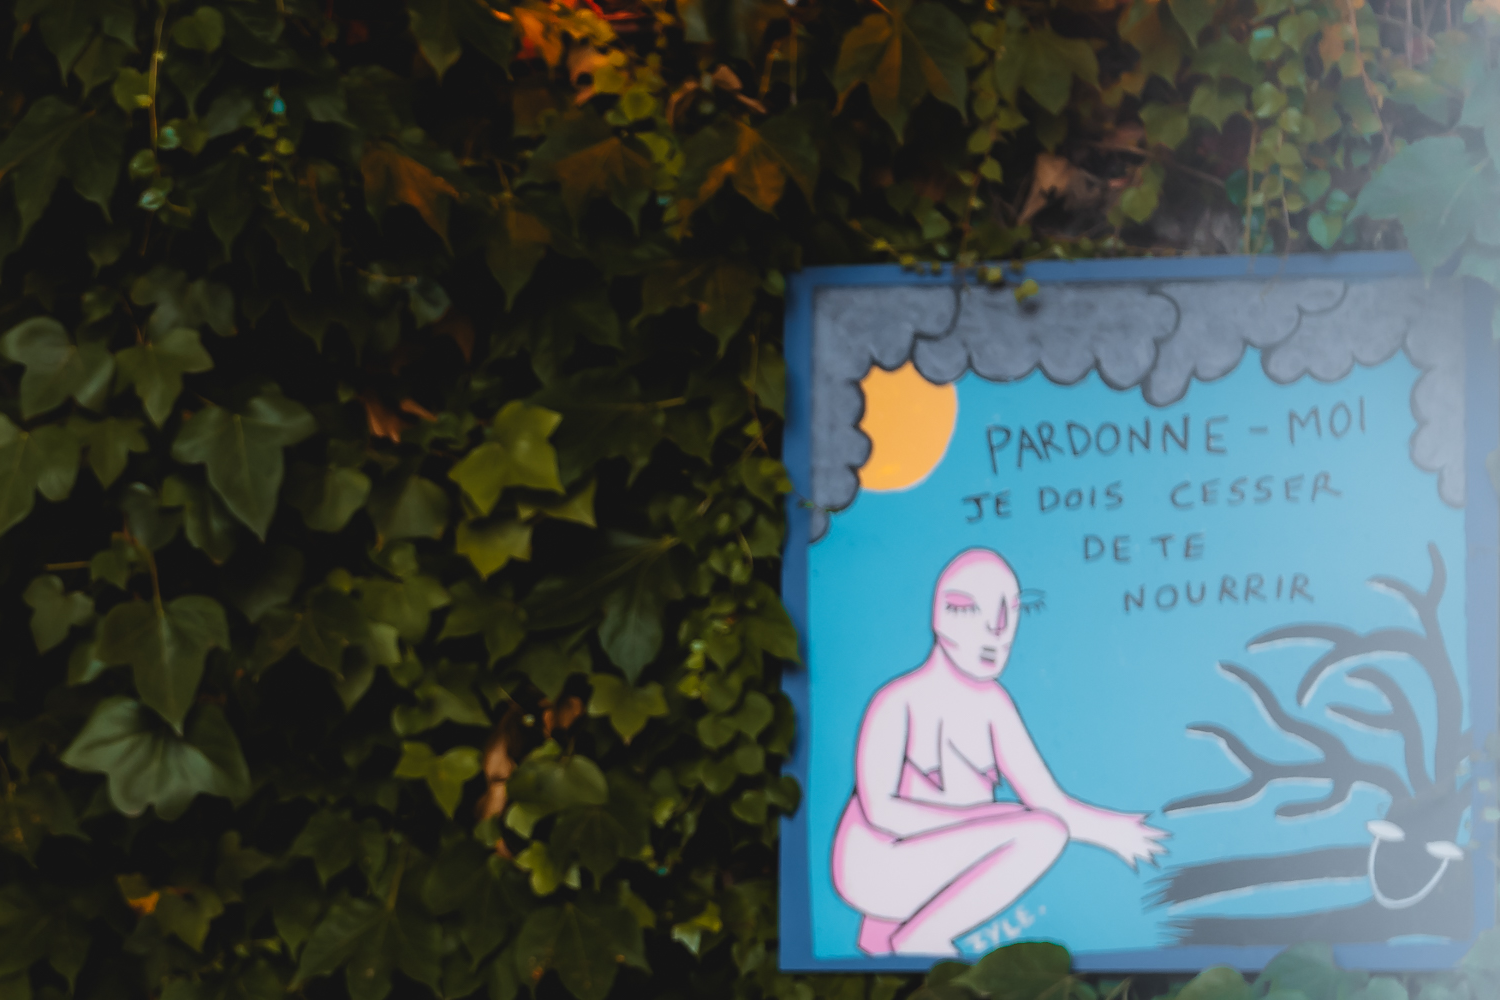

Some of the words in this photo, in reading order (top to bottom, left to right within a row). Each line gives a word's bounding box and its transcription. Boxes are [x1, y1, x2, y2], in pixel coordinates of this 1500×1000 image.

[986, 413, 1229, 474] PARDONNE
[1287, 396, 1366, 446] MOI
[962, 489, 1012, 524] JE
[1038, 481, 1124, 513] DOIS
[1170, 471, 1342, 510] CESSER
[1083, 534, 1131, 562] DE
[1150, 533, 1205, 562] TE
[1124, 573, 1315, 613] NOURRIR
